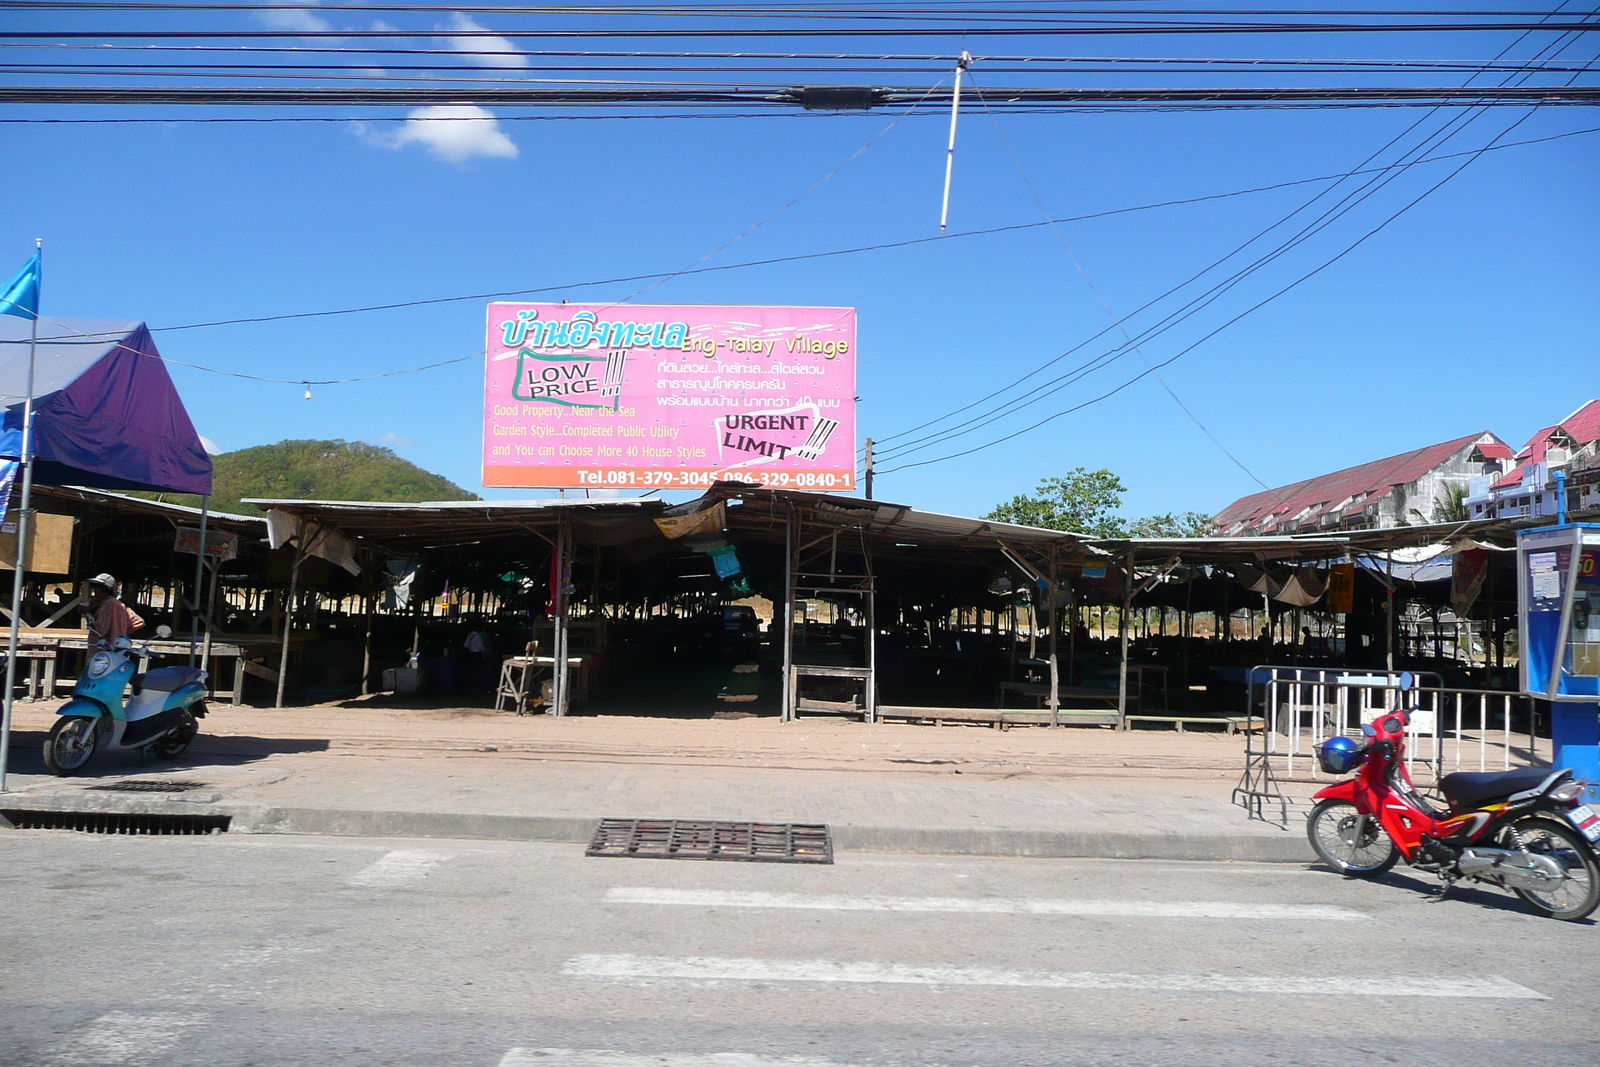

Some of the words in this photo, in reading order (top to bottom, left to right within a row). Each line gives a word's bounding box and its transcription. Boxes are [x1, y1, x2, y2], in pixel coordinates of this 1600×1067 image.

[501, 309, 688, 349] บ้านอิงทะเล
[681, 336, 774, 357] Eng-Talay
[786, 334, 848, 359] Village
[527, 362, 591, 385] LOW
[530, 378, 599, 399] PRICE
[656, 394, 739, 407] พร้อมแบบบ้าน
[744, 395, 790, 408] มากกว่า
[794, 395, 813, 407] 40
[817, 398, 841, 408] แบบ
[493, 404, 518, 416] Good
[598, 405, 615, 417] the
[618, 405, 636, 417] Sea
[724, 414, 809, 431] URGENT
[492, 424, 527, 436] Garden
[617, 425, 646, 438] Public
[650, 425, 680, 439] Utility
[492, 444, 511, 456] and
[515, 444, 534, 456] You
[538, 446, 555, 456] can
[559, 444, 594, 457] Choose
[597, 445, 623, 457] More
[626, 445, 638, 457] 40
[642, 446, 673, 458] House
[677, 446, 706, 459] Styles
[722, 432, 792, 461] LIMIT
[577, 470, 719, 485] Tel.081-379-3045
